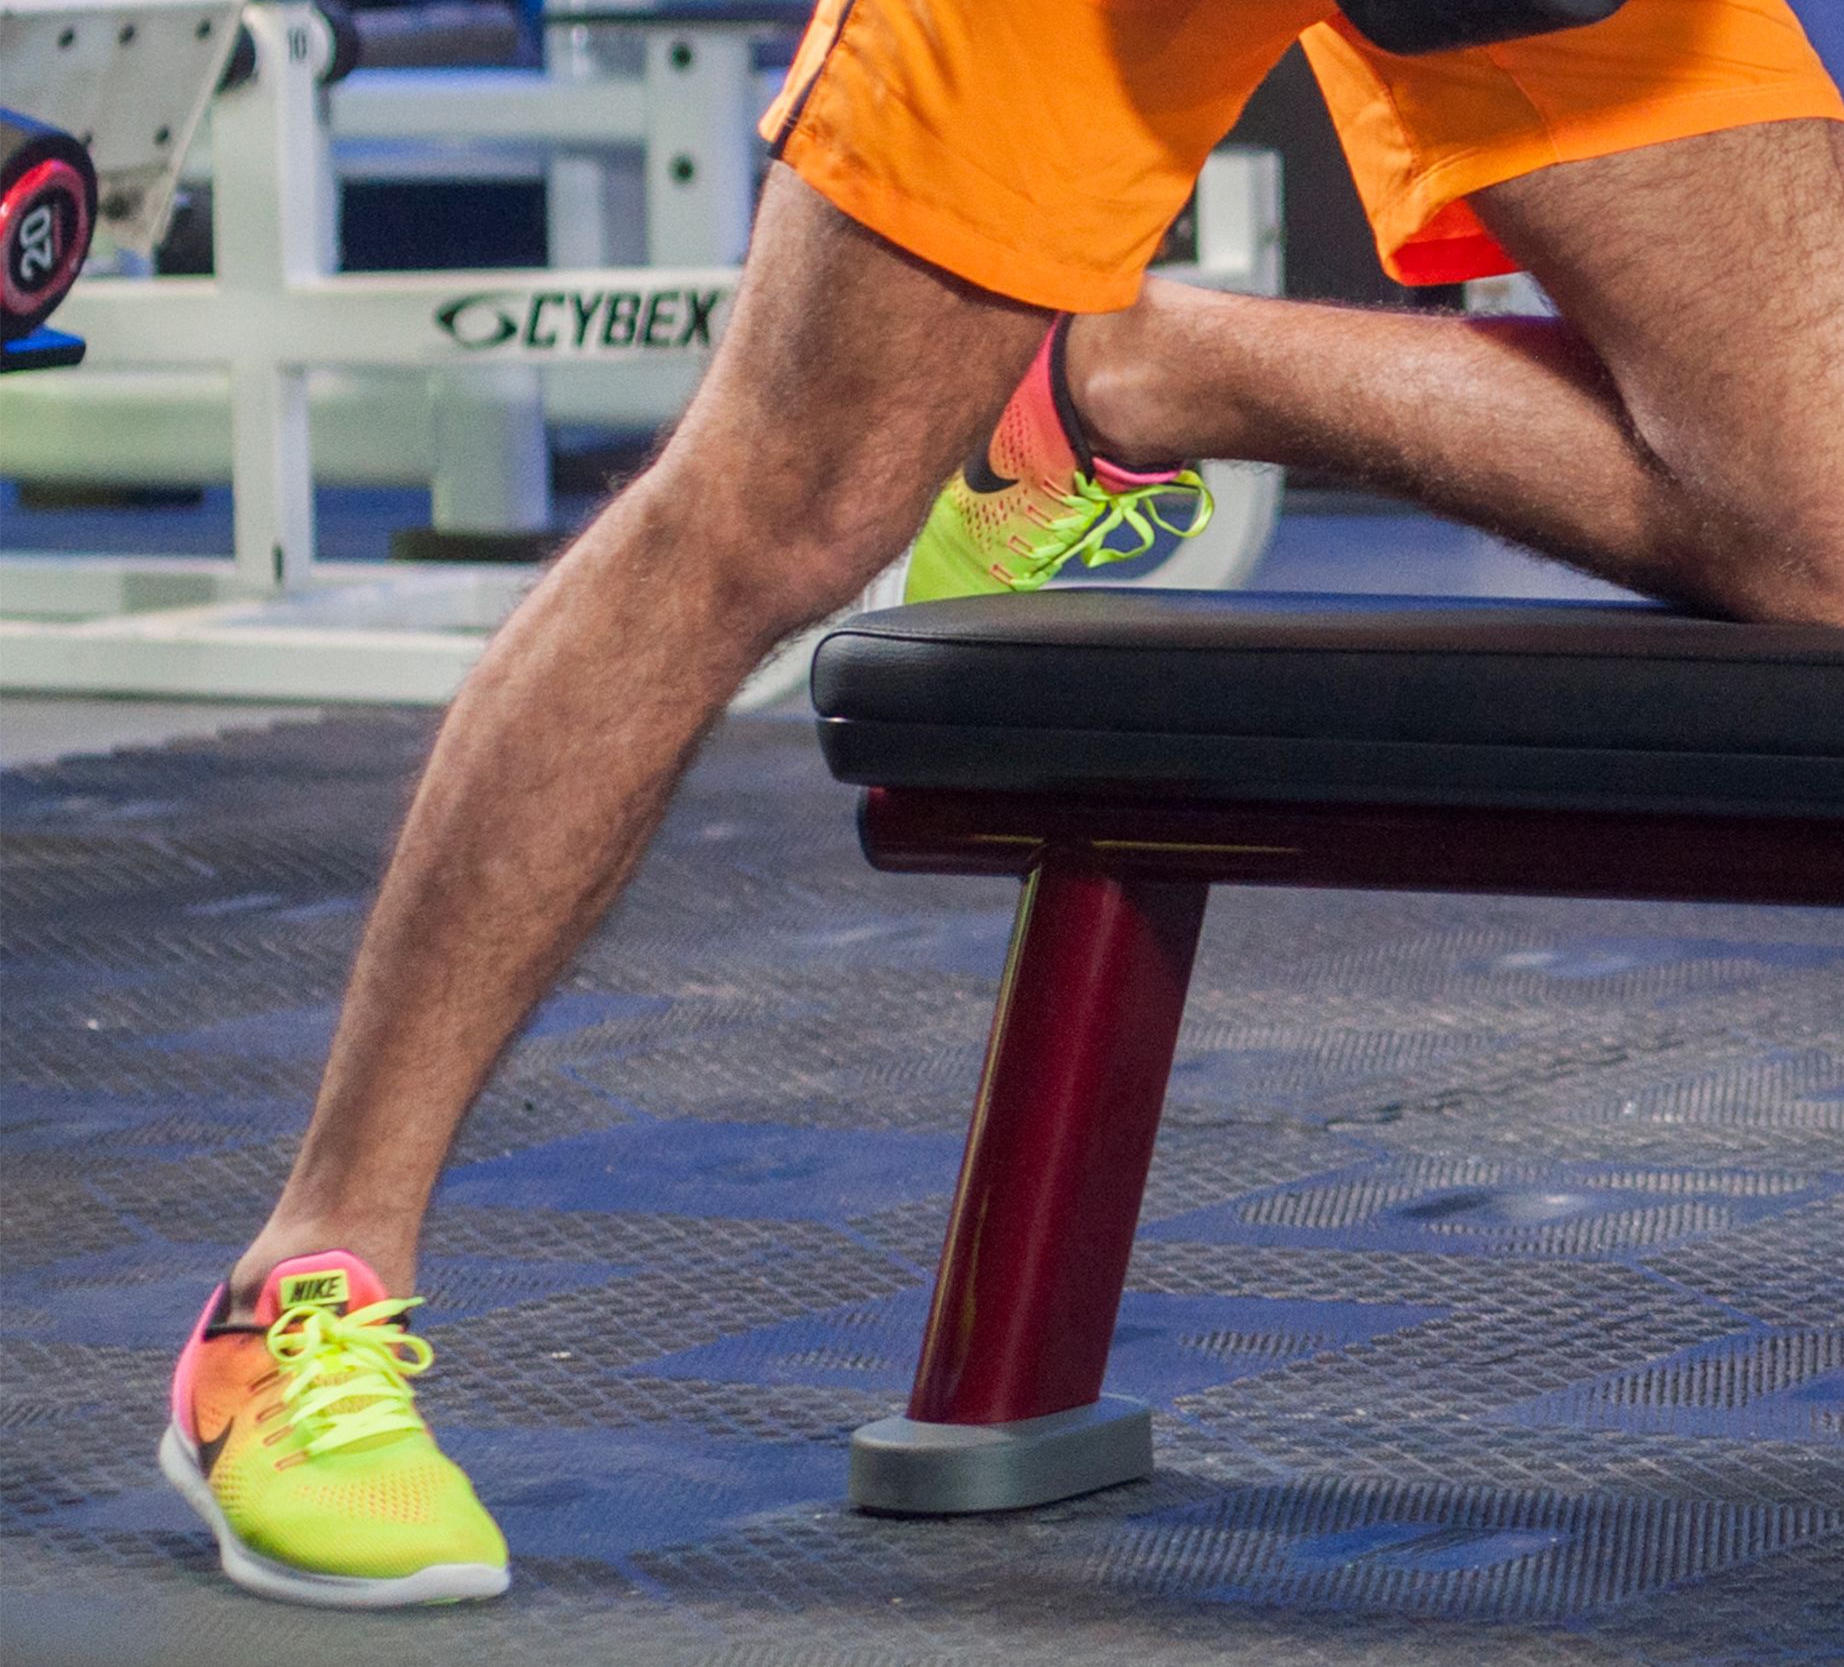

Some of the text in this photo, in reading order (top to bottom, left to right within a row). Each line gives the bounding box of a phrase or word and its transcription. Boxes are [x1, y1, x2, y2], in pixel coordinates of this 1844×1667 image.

[20, 205, 52, 281] 20
[525, 289, 722, 347] CYBEX
[288, 1275, 342, 1304] NIKE
